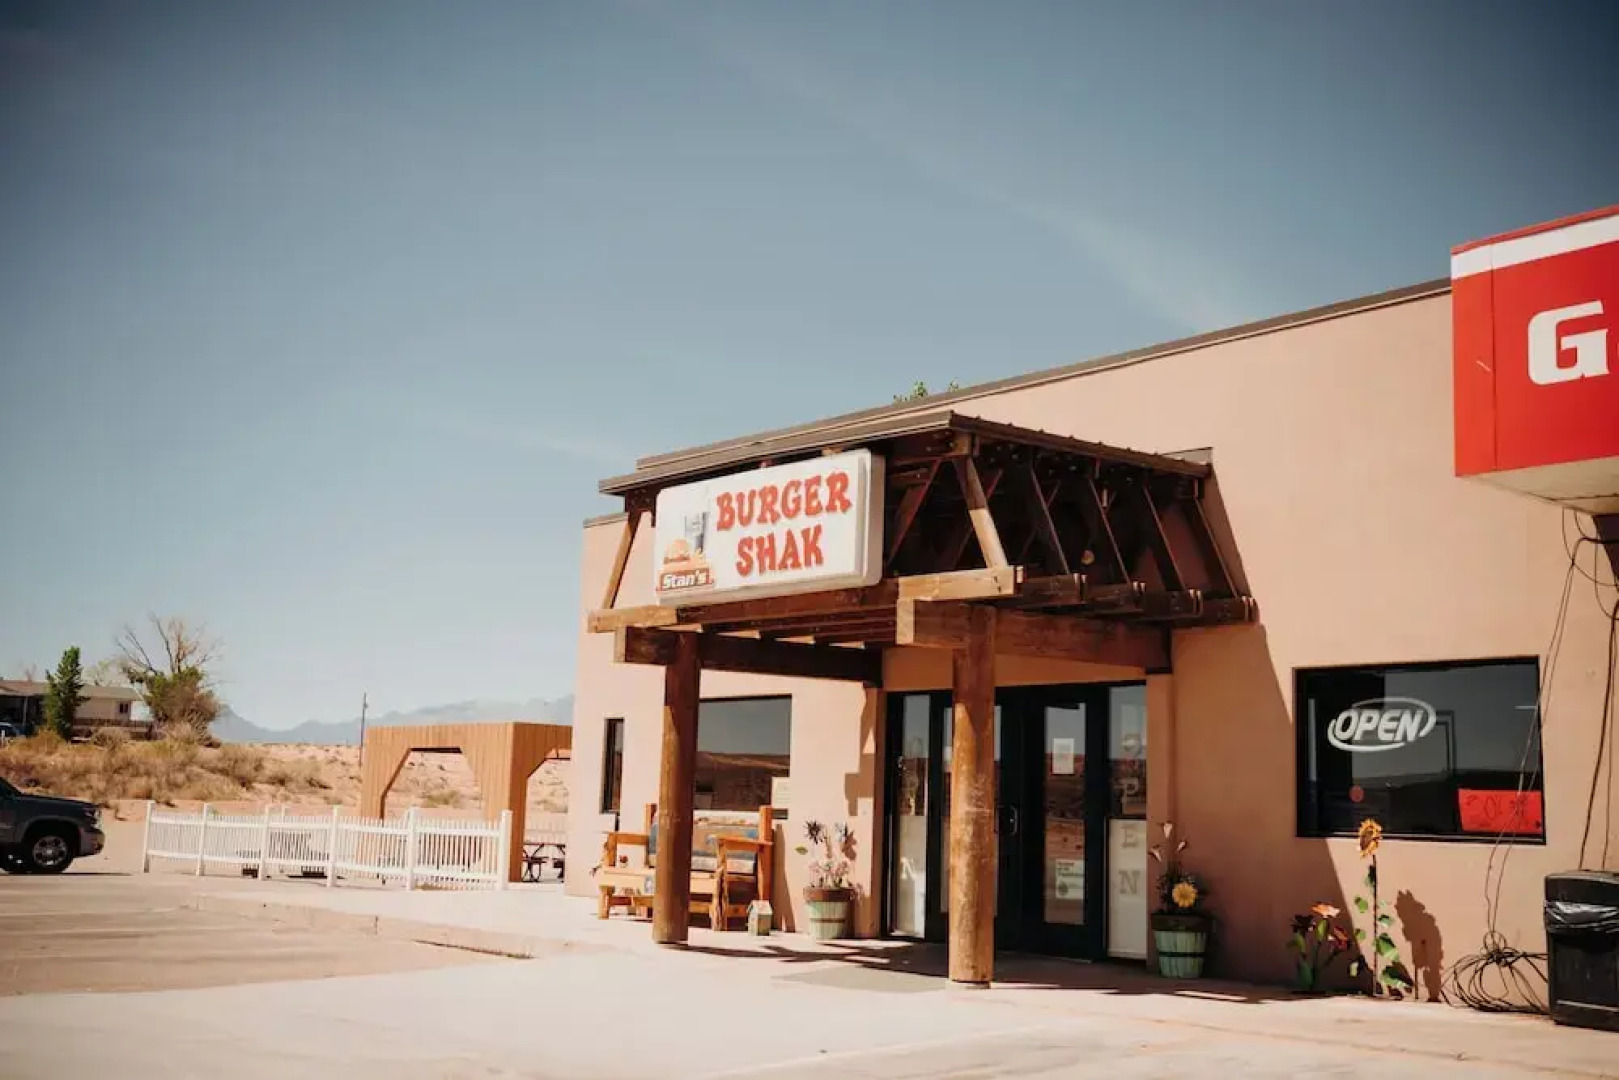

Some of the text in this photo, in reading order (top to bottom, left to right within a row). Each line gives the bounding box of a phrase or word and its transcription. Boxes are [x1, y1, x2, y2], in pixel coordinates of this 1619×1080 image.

[1528, 300, 1619, 385] G
[716, 471, 852, 531] BURGER
[736, 525, 824, 577] SHAK
[662, 570, 707, 589] Stan's
[1335, 709, 1424, 742] OPEN
